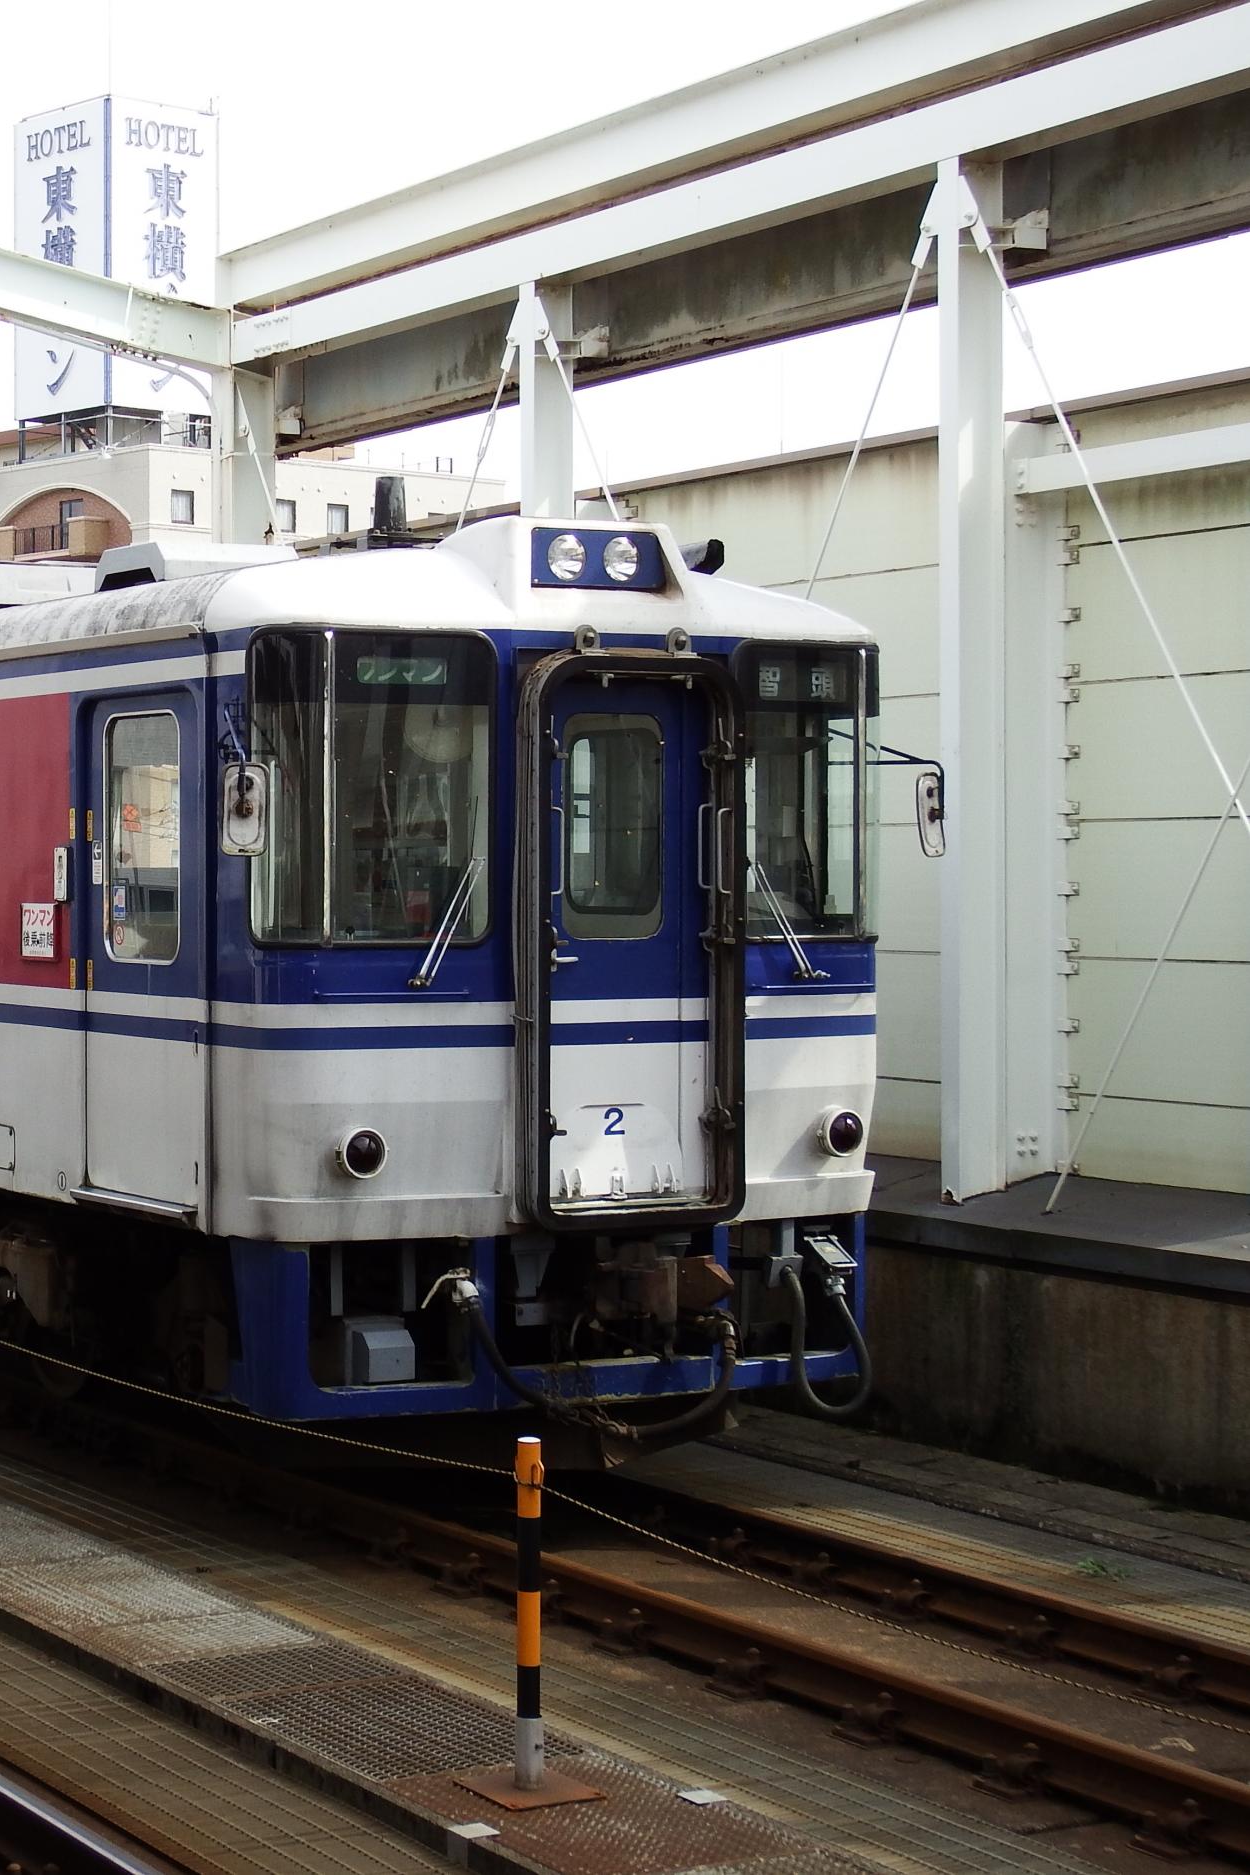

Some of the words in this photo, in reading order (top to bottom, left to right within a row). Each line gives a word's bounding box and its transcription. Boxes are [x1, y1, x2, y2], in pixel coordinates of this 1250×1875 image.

[26, 119, 92, 162] HOTEL
[124, 117, 204, 157] HOTEL
[23, 909, 54, 926] ワンマン
[604, 1107, 625, 1135] 2
